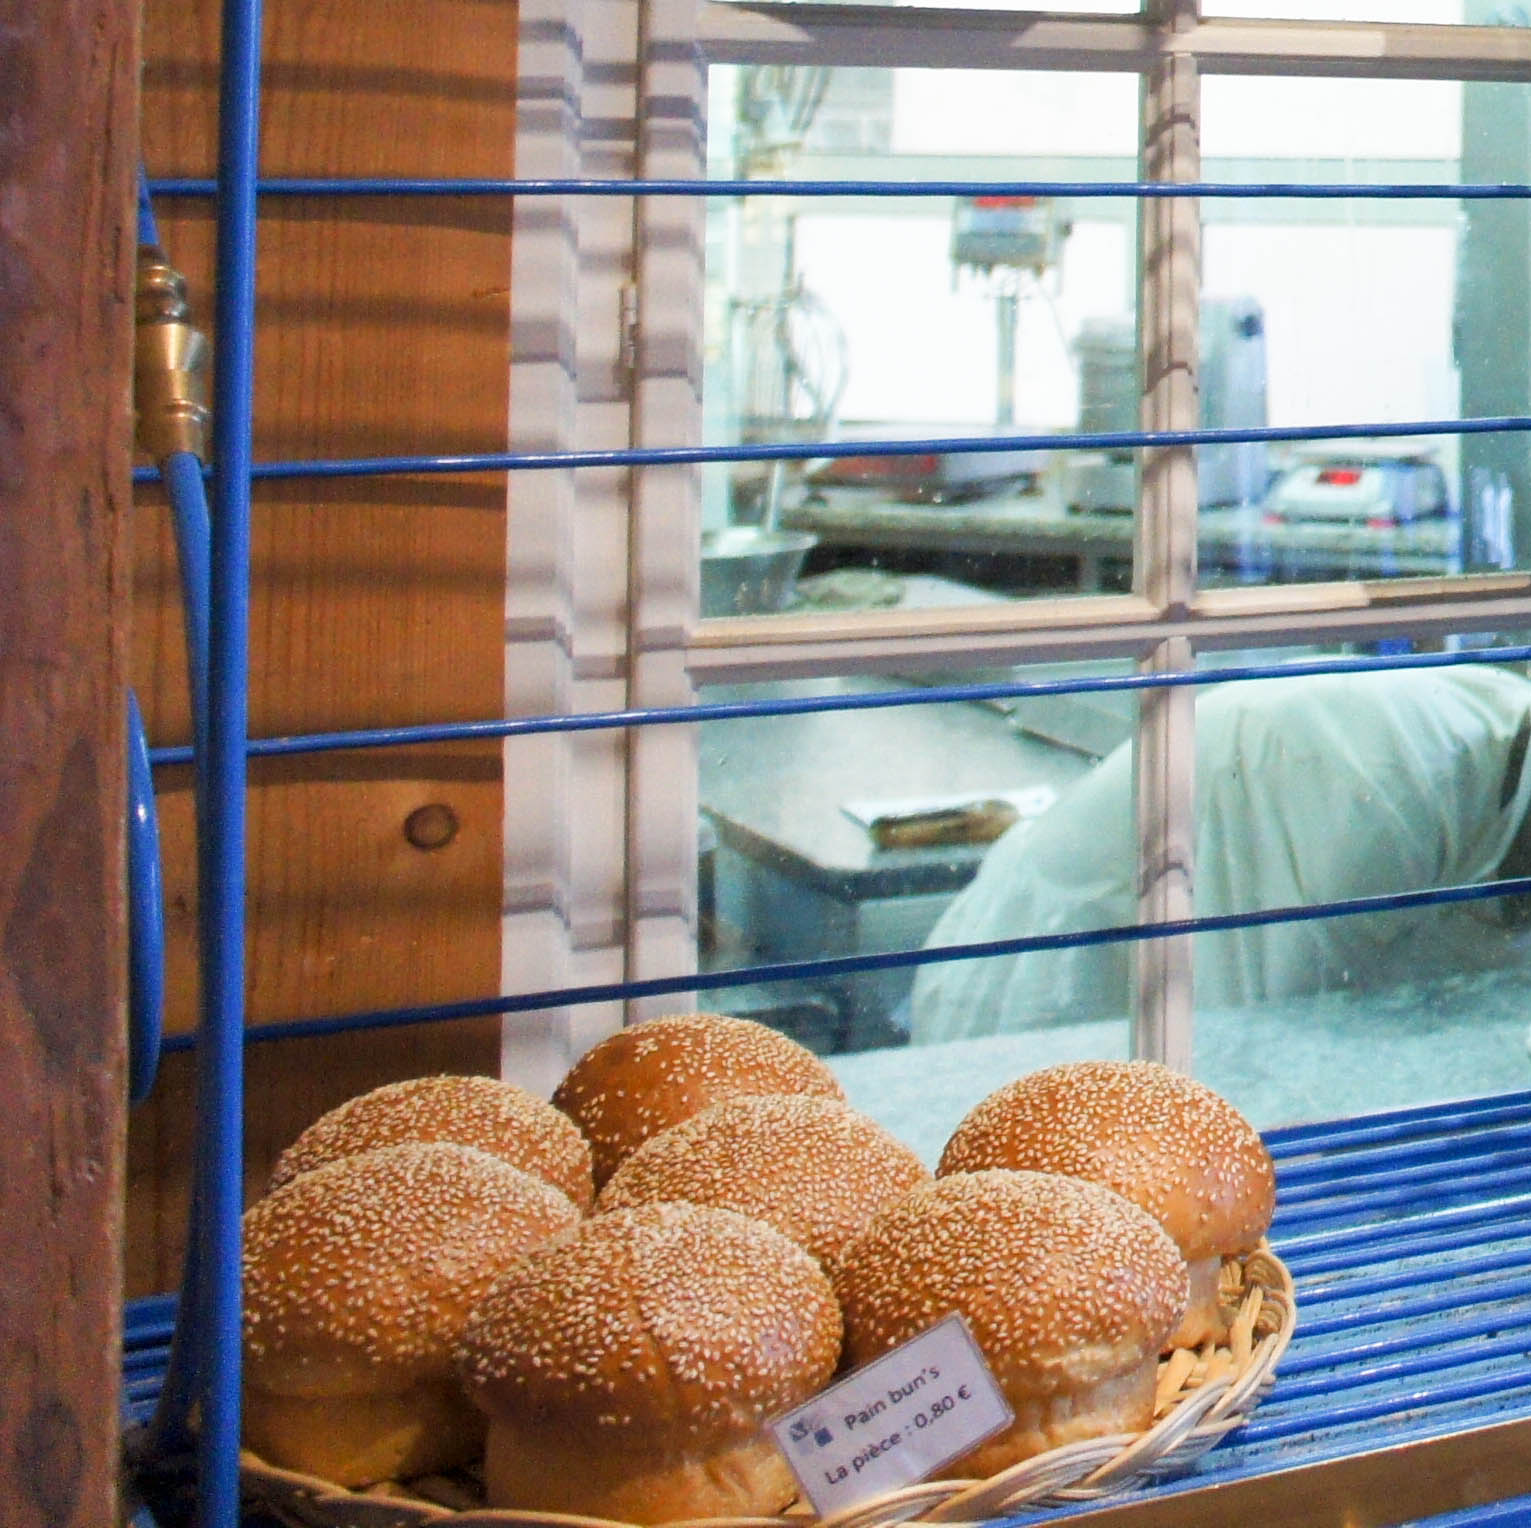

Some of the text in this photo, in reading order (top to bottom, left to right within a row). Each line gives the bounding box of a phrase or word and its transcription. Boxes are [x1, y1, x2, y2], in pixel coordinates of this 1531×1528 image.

[824, 1464, 849, 1486] La
[851, 1431, 902, 1474] pièce
[957, 1383, 973, 1402] €
[844, 1365, 941, 1431] Pain bun's
